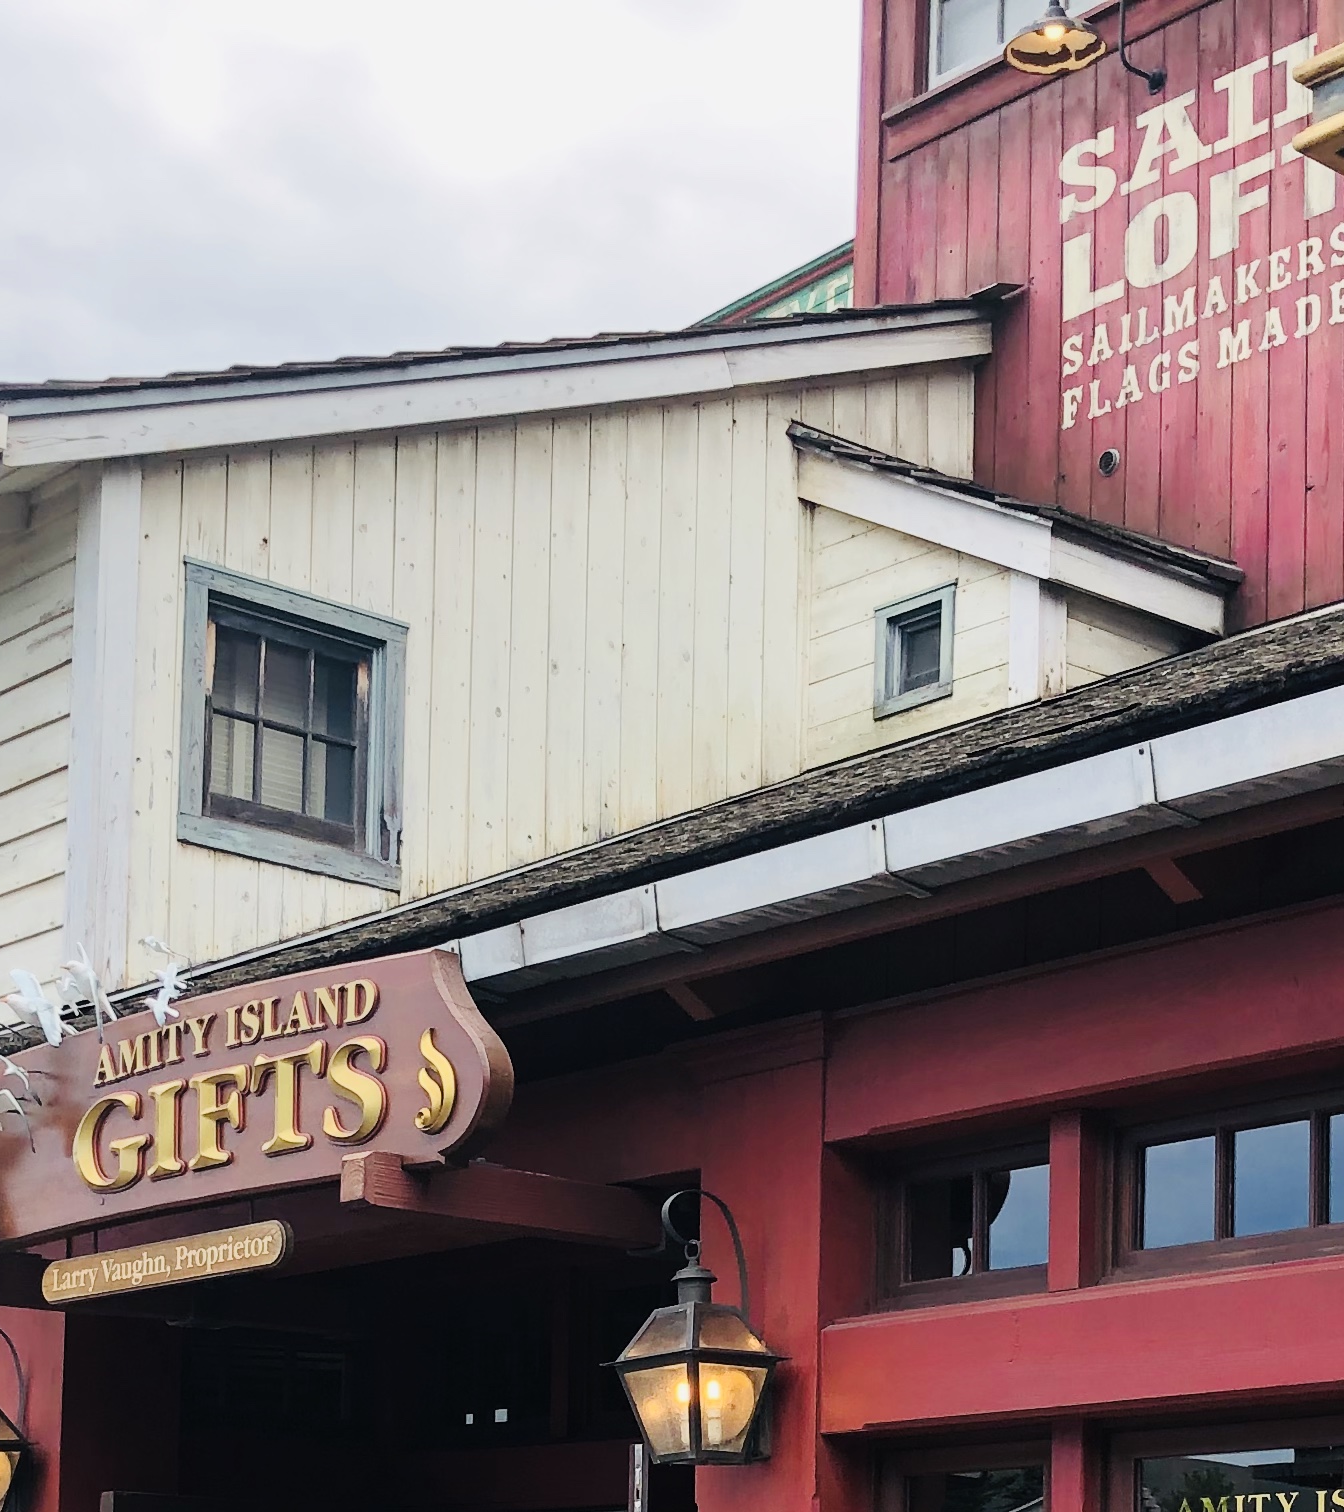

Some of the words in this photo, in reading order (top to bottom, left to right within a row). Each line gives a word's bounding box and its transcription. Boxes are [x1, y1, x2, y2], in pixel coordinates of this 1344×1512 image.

[1061, 339, 1200, 431] FLAGS
[93, 1017, 215, 1087] AMITY
[225, 977, 379, 1049] ISLAND
[72, 1035, 388, 1194] GIFTS
[52, 1268, 98, 1292] Larry
[101, 1252, 171, 1285] Vaughn,
[175, 1234, 273, 1273] Proprietor
